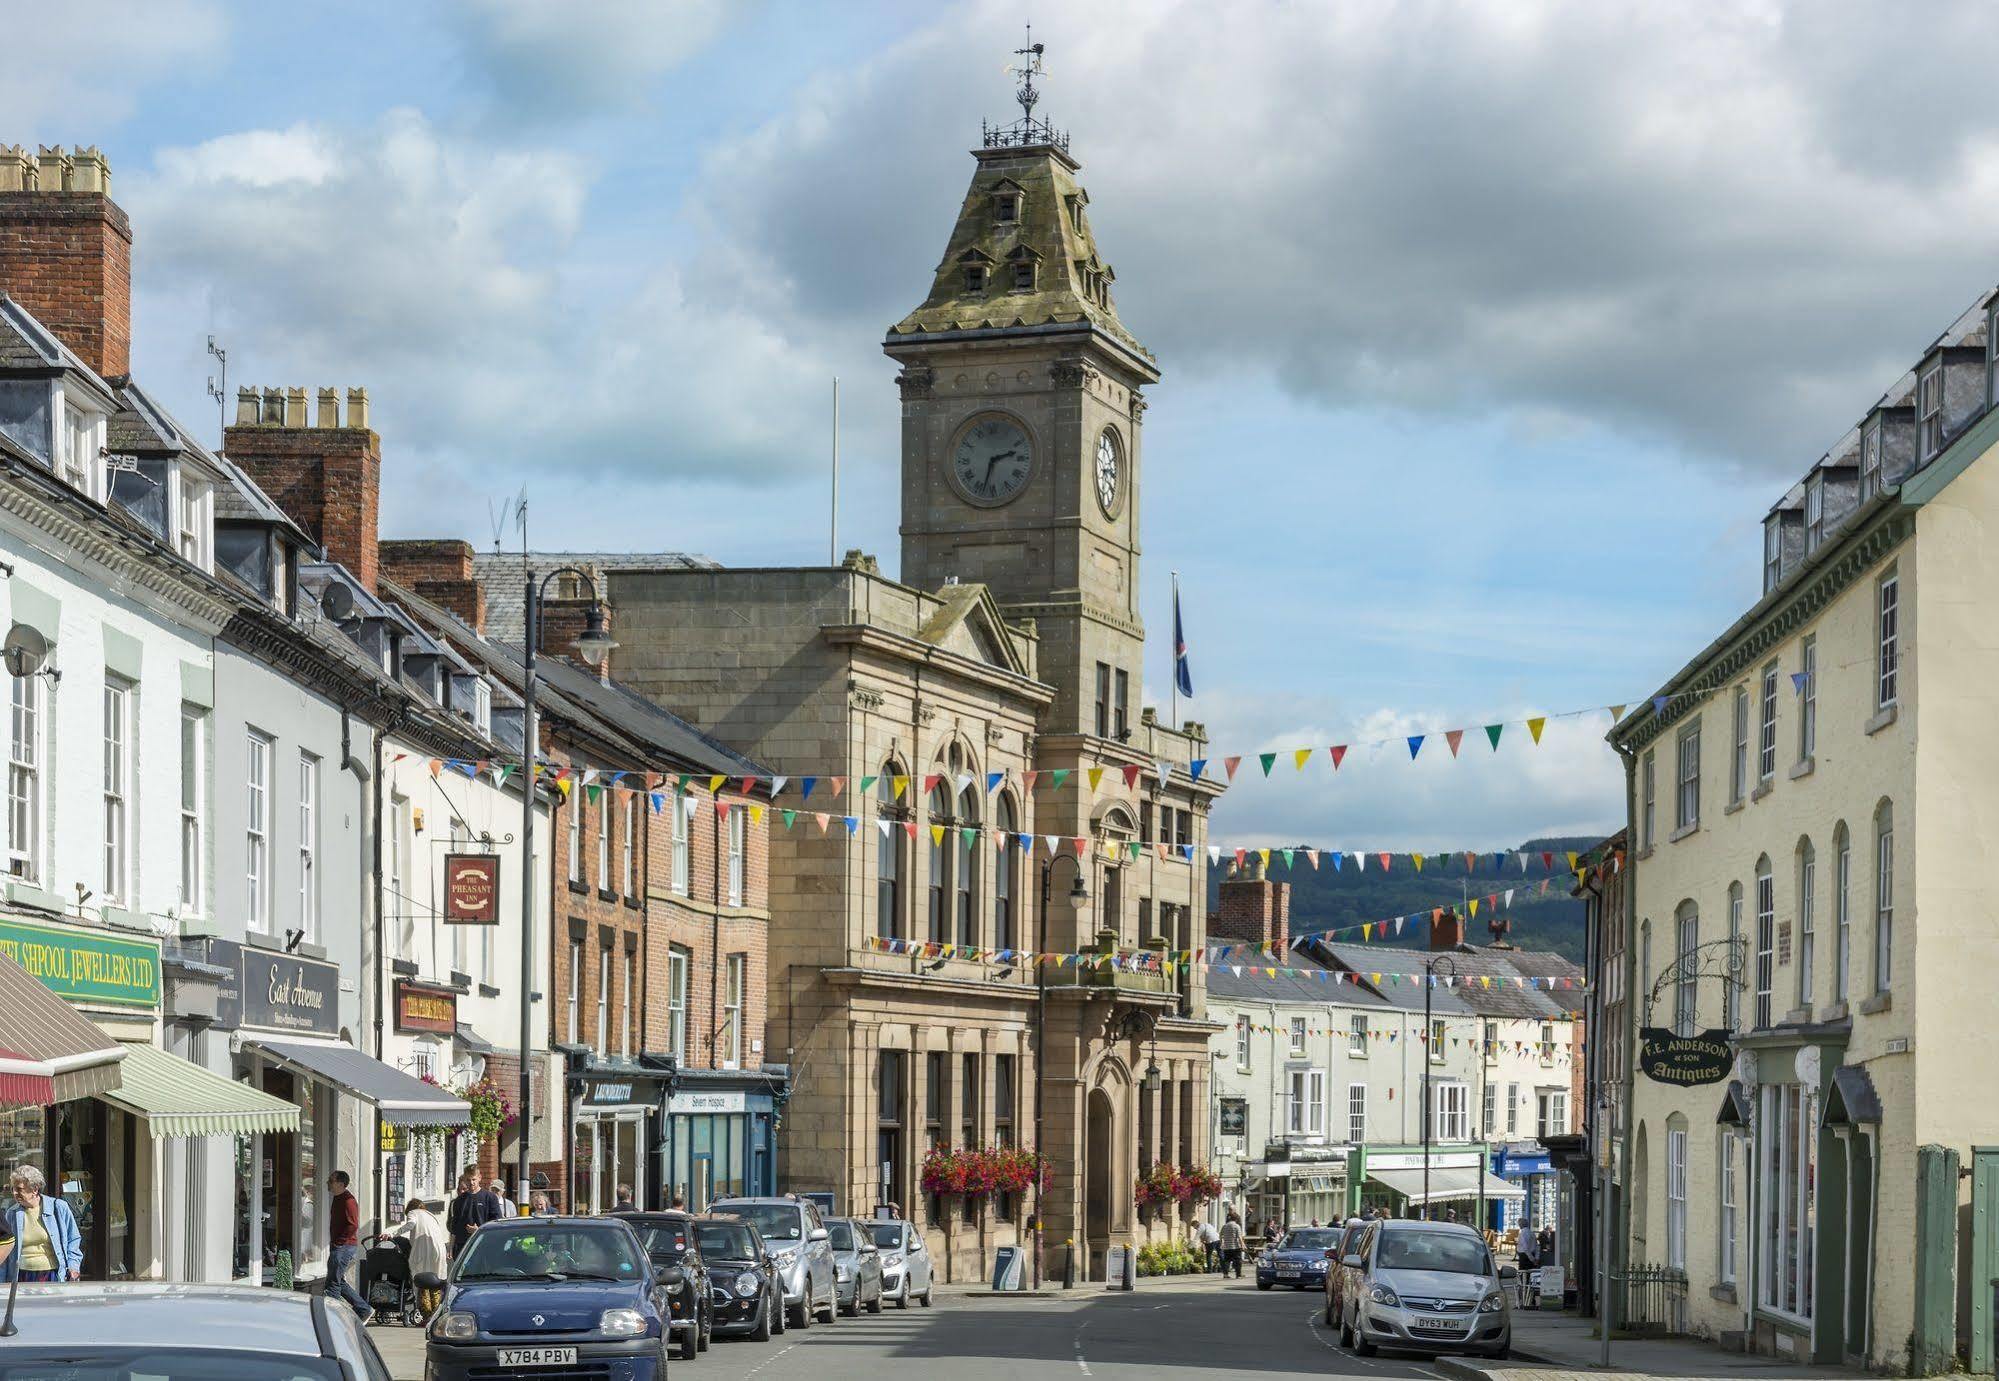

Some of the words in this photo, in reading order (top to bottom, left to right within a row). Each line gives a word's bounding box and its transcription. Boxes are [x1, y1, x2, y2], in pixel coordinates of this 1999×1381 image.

[452, 884, 492, 893] PHEASANT
[71, 949, 131, 987] JEWELLERS
[132, 957, 153, 988] LTD
[268, 963, 291, 1005] East
[291, 966, 323, 1010] Avenue
[1668, 1040, 1728, 1058] ANDERSON
[1651, 1062, 1721, 1082] Antiques
[504, 1350, 540, 1364] X784
[544, 1349, 571, 1363] PBV
